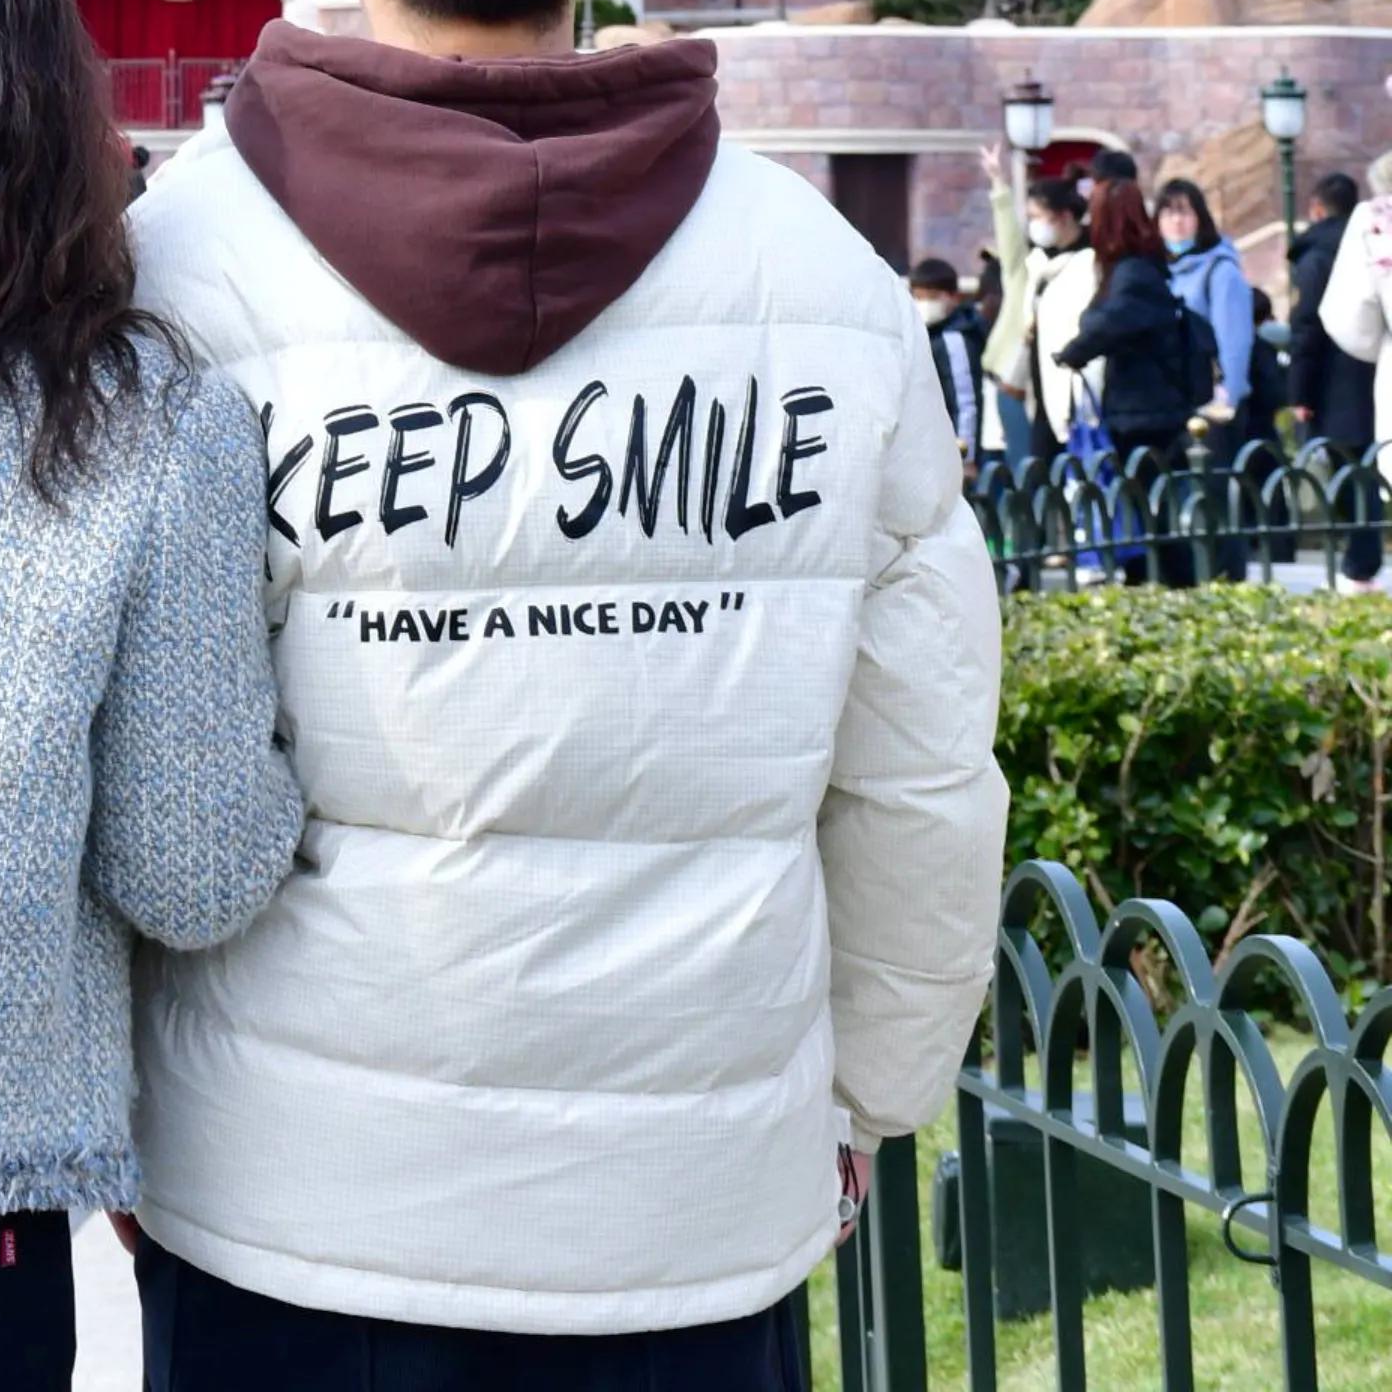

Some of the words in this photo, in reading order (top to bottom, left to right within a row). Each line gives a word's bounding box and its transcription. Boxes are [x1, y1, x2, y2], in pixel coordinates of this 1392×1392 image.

[260, 389, 511, 549] KEEP
[552, 372, 835, 546] SMILE
[483, 607, 515, 639] A
[527, 602, 620, 637] NICE
